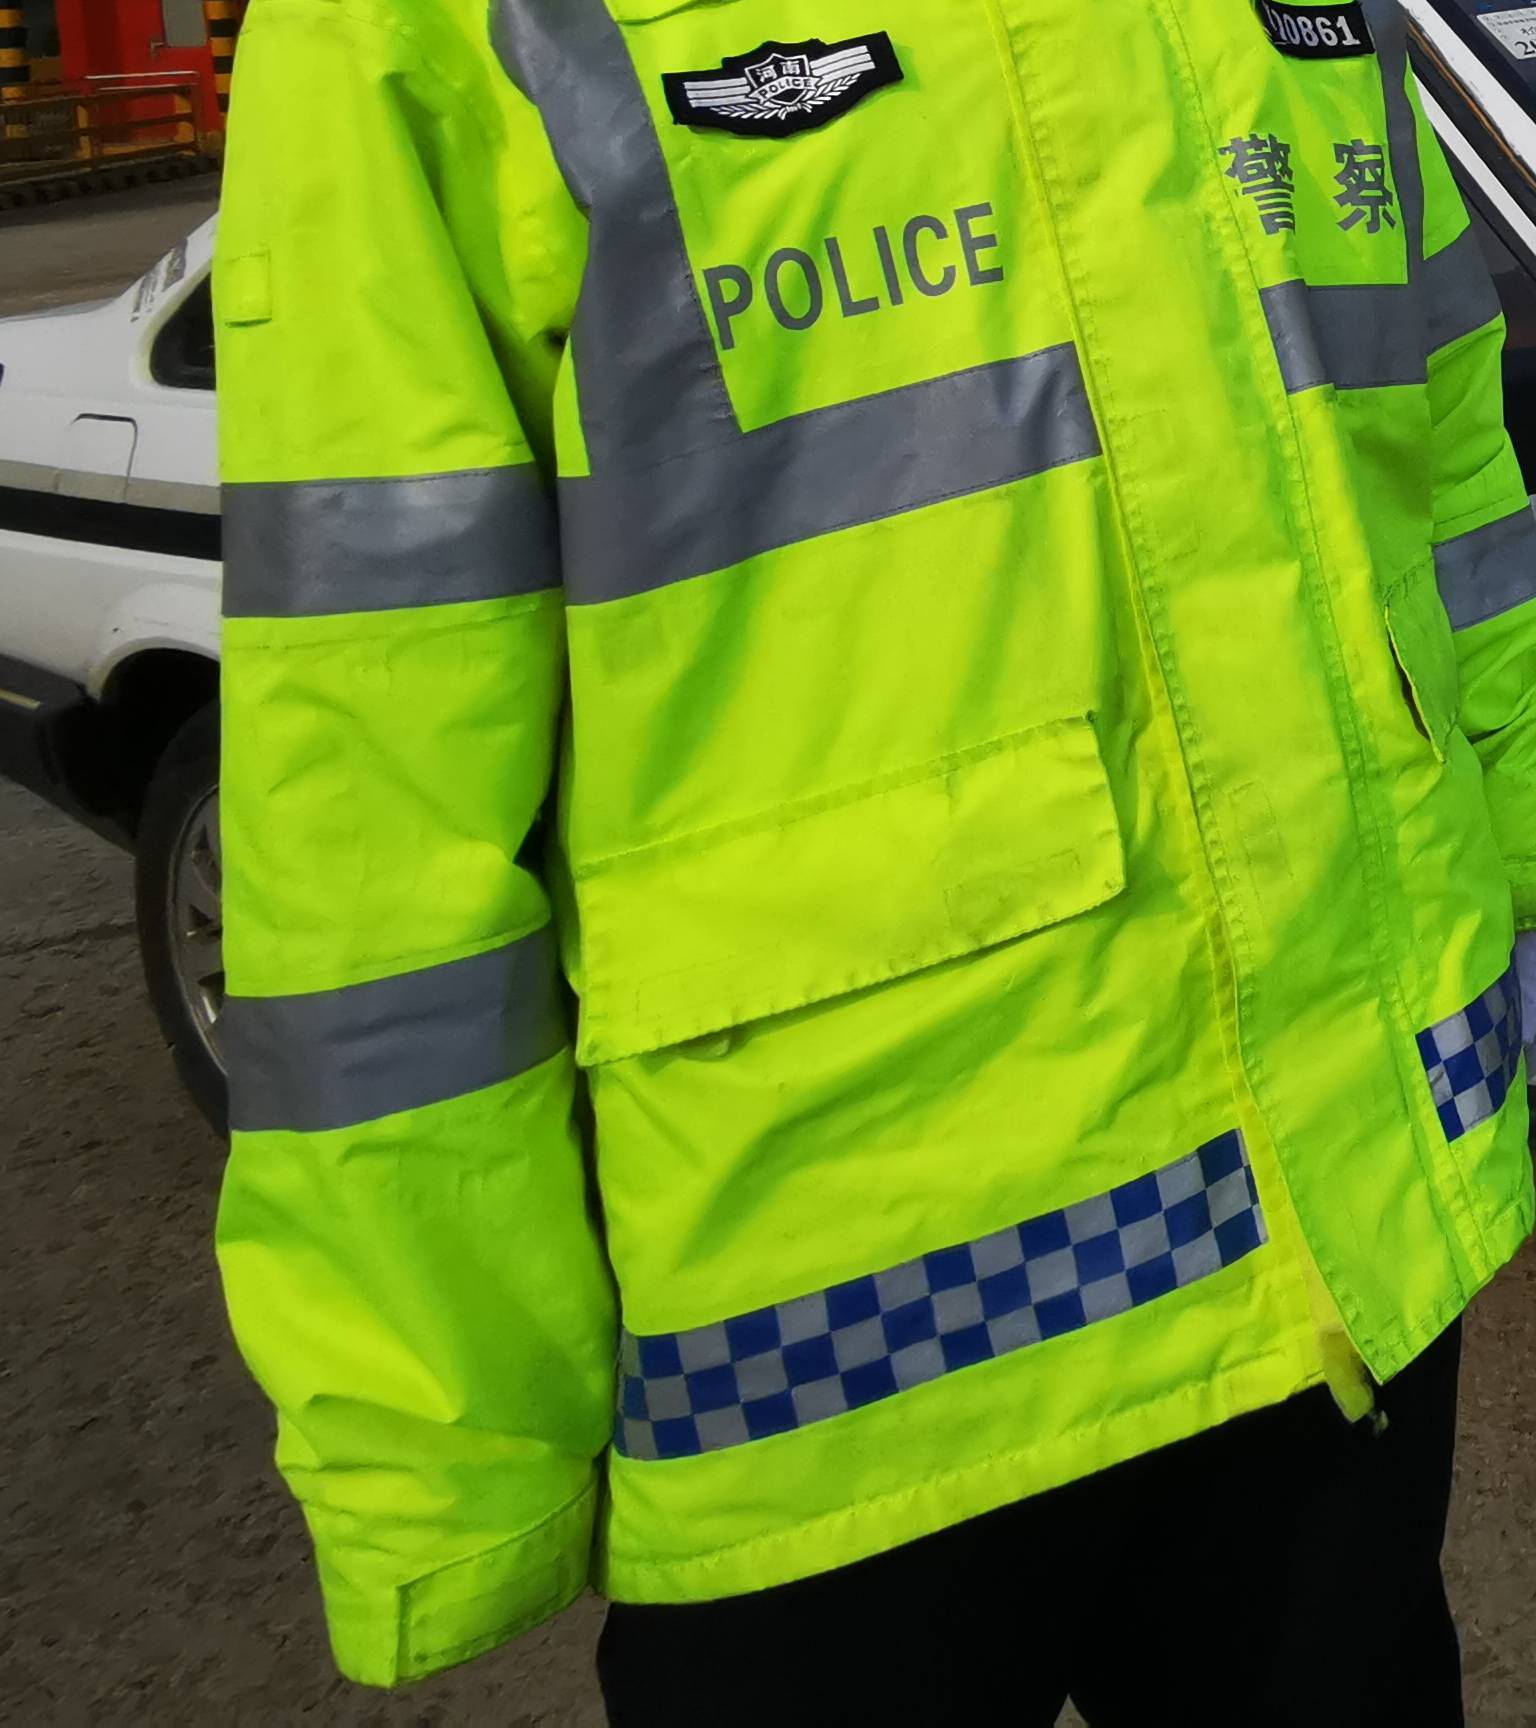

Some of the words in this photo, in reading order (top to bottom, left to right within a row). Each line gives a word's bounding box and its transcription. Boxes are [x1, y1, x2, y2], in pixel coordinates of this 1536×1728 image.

[756, 60, 801, 82] 河南
[761, 78, 812, 99] POLICE
[1220, 133, 1397, 235] 警察
[702, 201, 1005, 351] POLICE
